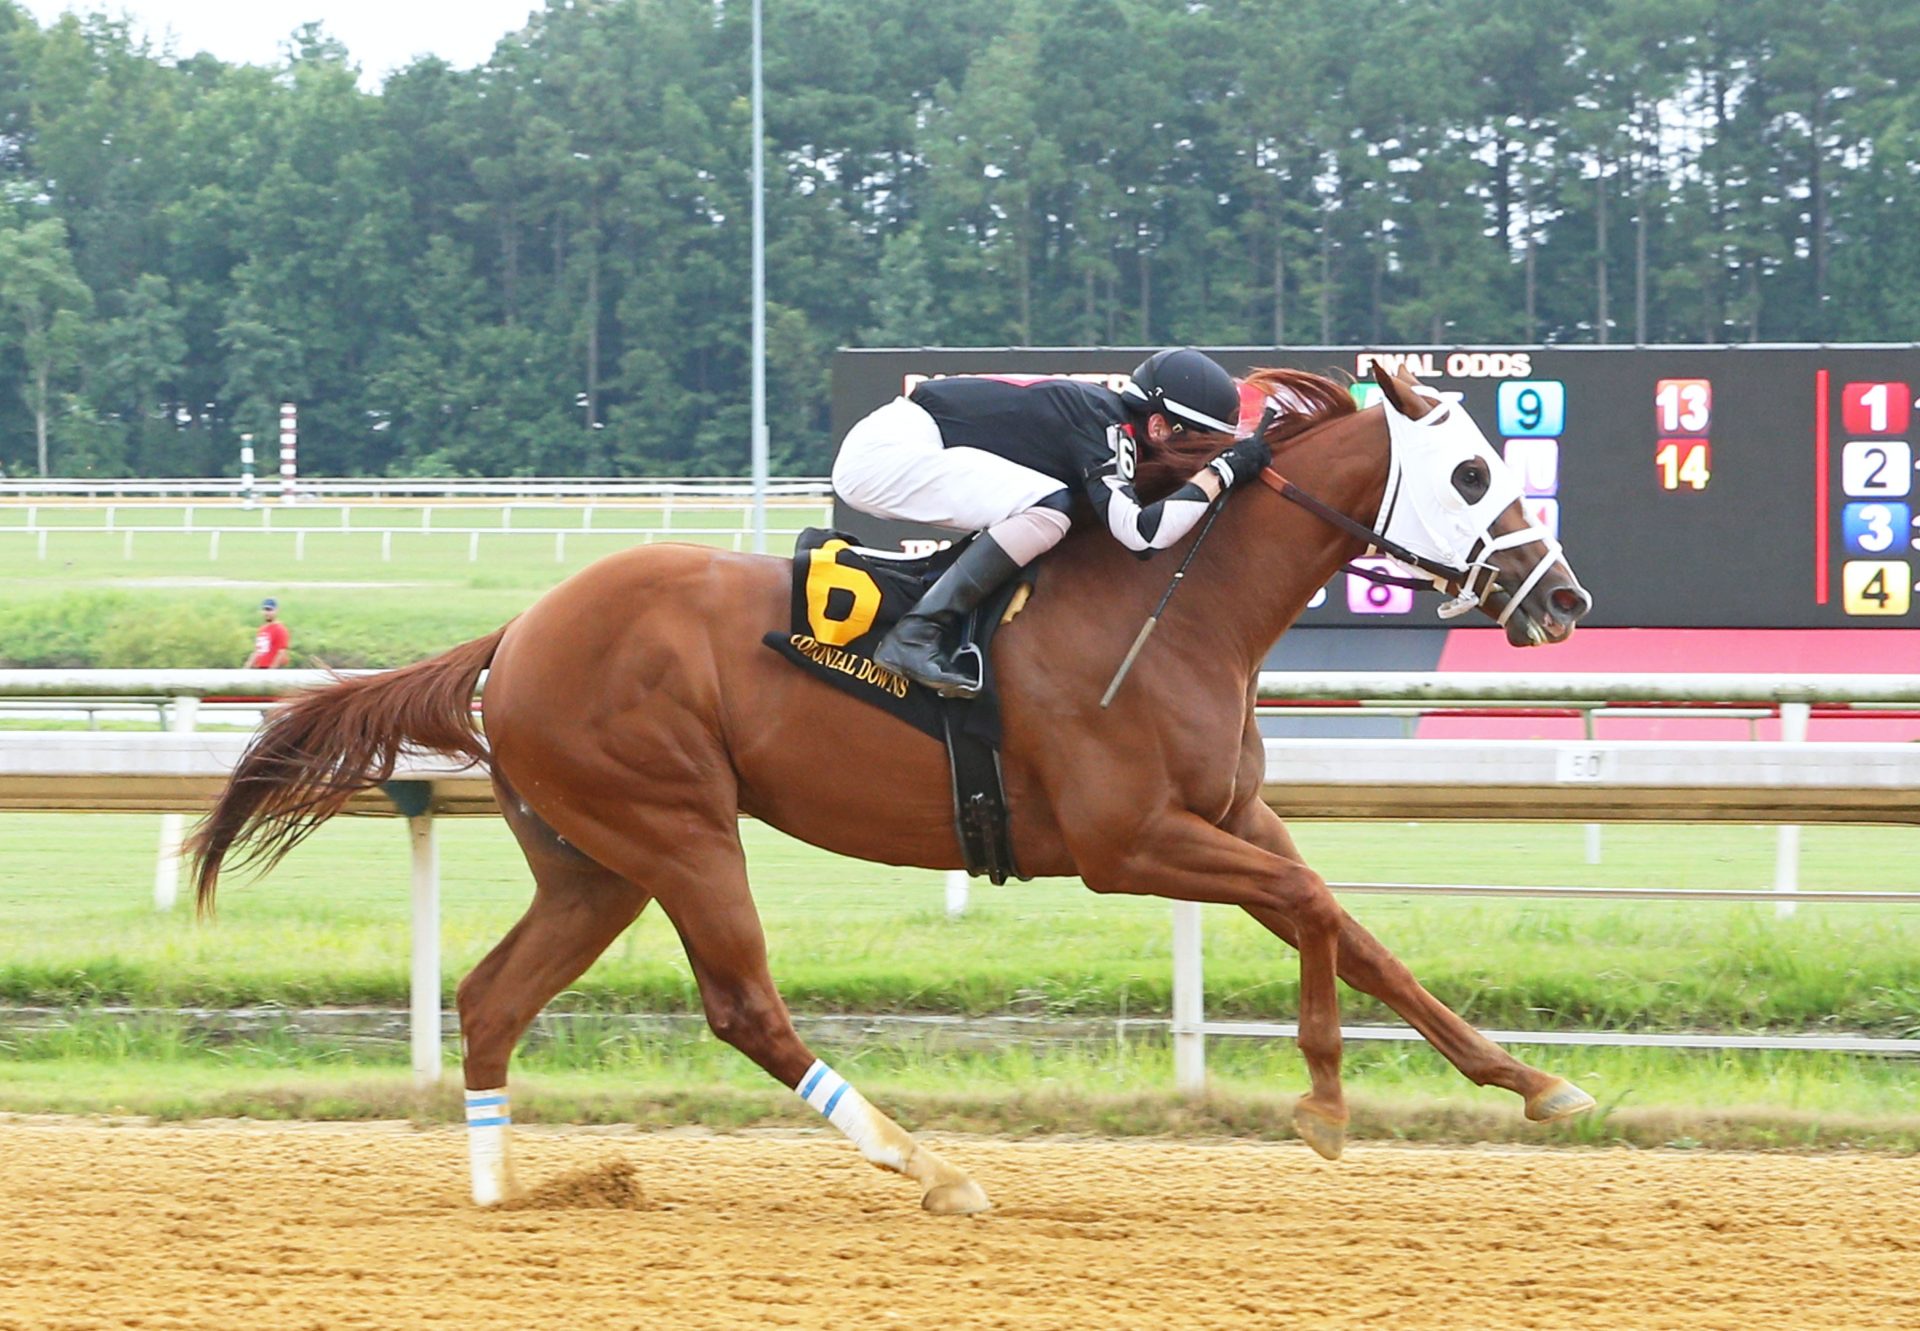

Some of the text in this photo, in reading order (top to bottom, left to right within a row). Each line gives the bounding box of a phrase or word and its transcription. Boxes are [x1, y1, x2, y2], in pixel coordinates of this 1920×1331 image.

[1446, 353, 1532, 378] ODDS
[1517, 388, 1542, 430] 9
[1656, 384, 1709, 432] 13
[1860, 384, 1887, 431] 1
[1119, 437, 1135, 480] 6
[1656, 444, 1710, 490] 14
[1863, 448, 1887, 488] 2
[1858, 504, 1893, 552] 3
[806, 538, 883, 647] 6
[1861, 567, 1890, 608] 4
[790, 634, 909, 698] COLONIAL DOWNS
